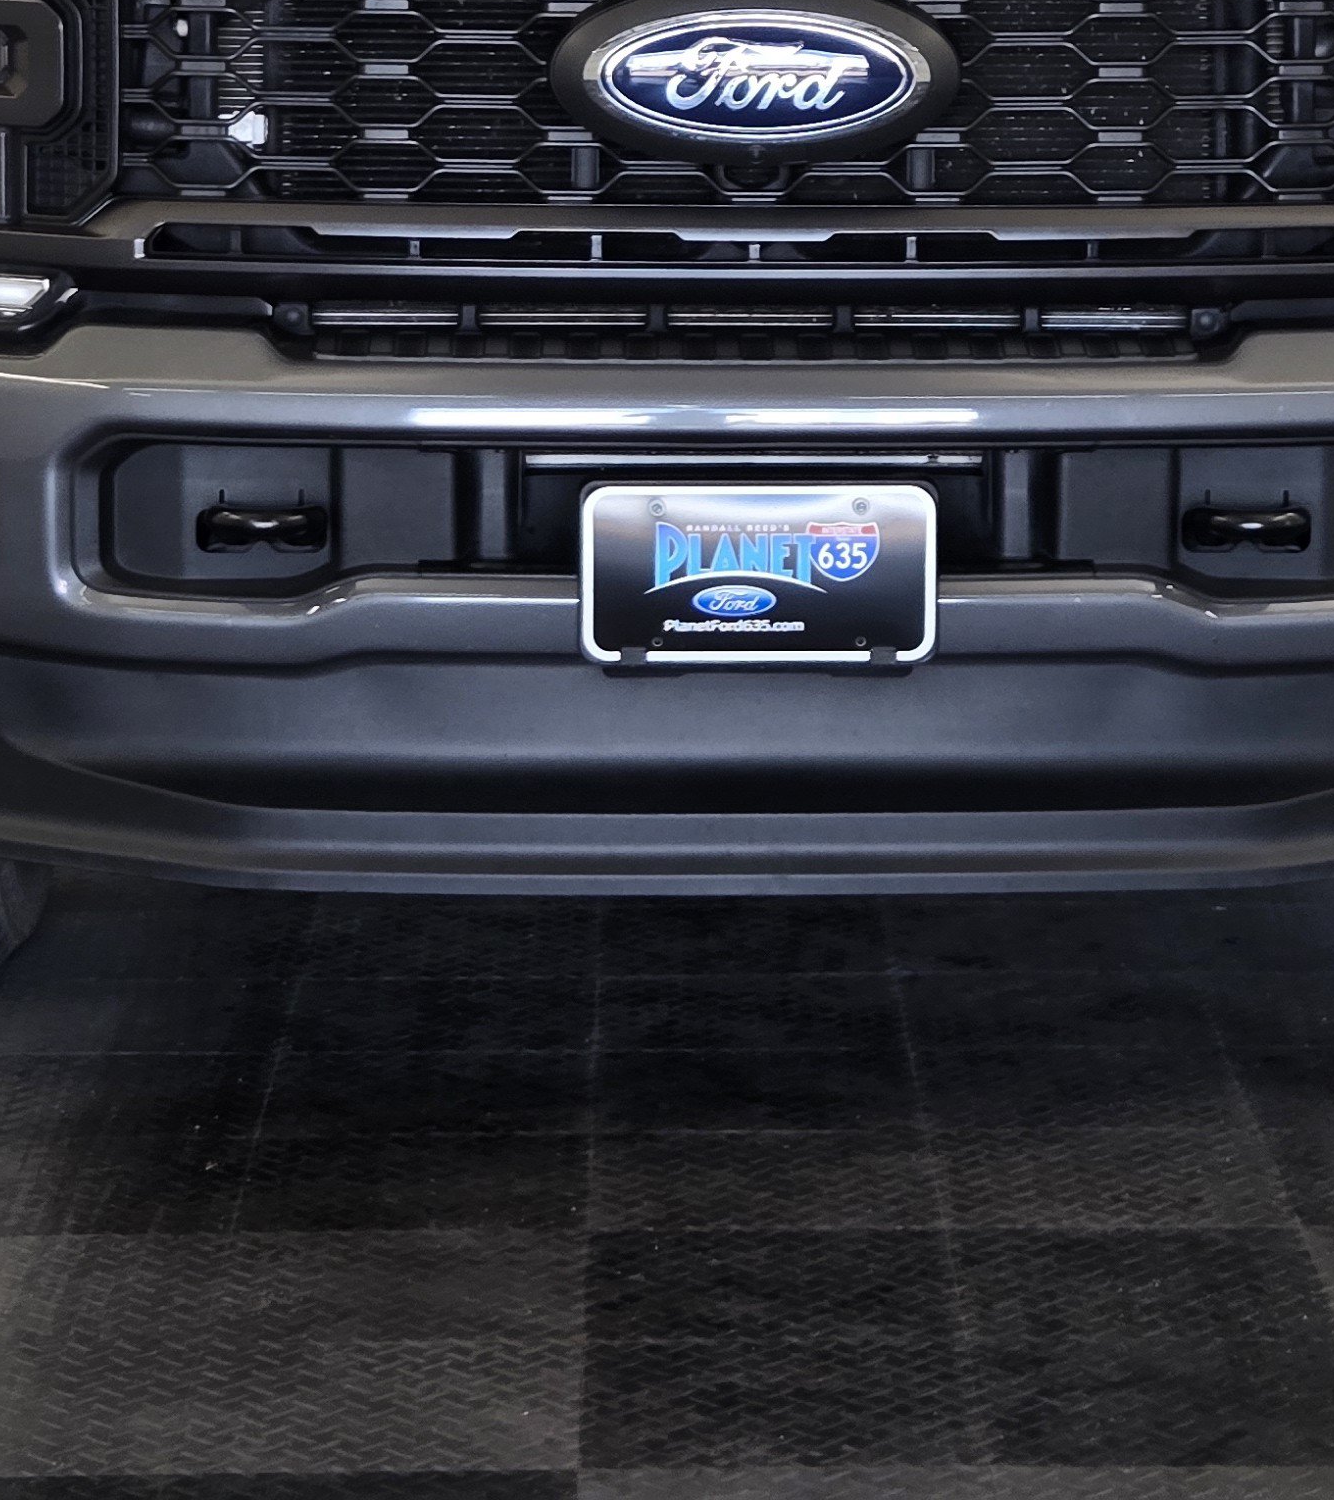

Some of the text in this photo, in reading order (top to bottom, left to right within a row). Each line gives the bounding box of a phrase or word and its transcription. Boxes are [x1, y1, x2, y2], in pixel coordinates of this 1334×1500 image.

[665, 35, 848, 111] Ford
[653, 520, 816, 587] PLANET
[817, 542, 868, 570] 635
[708, 590, 760, 612] Ford
[663, 619, 805, 632] PlanetFord635.com
